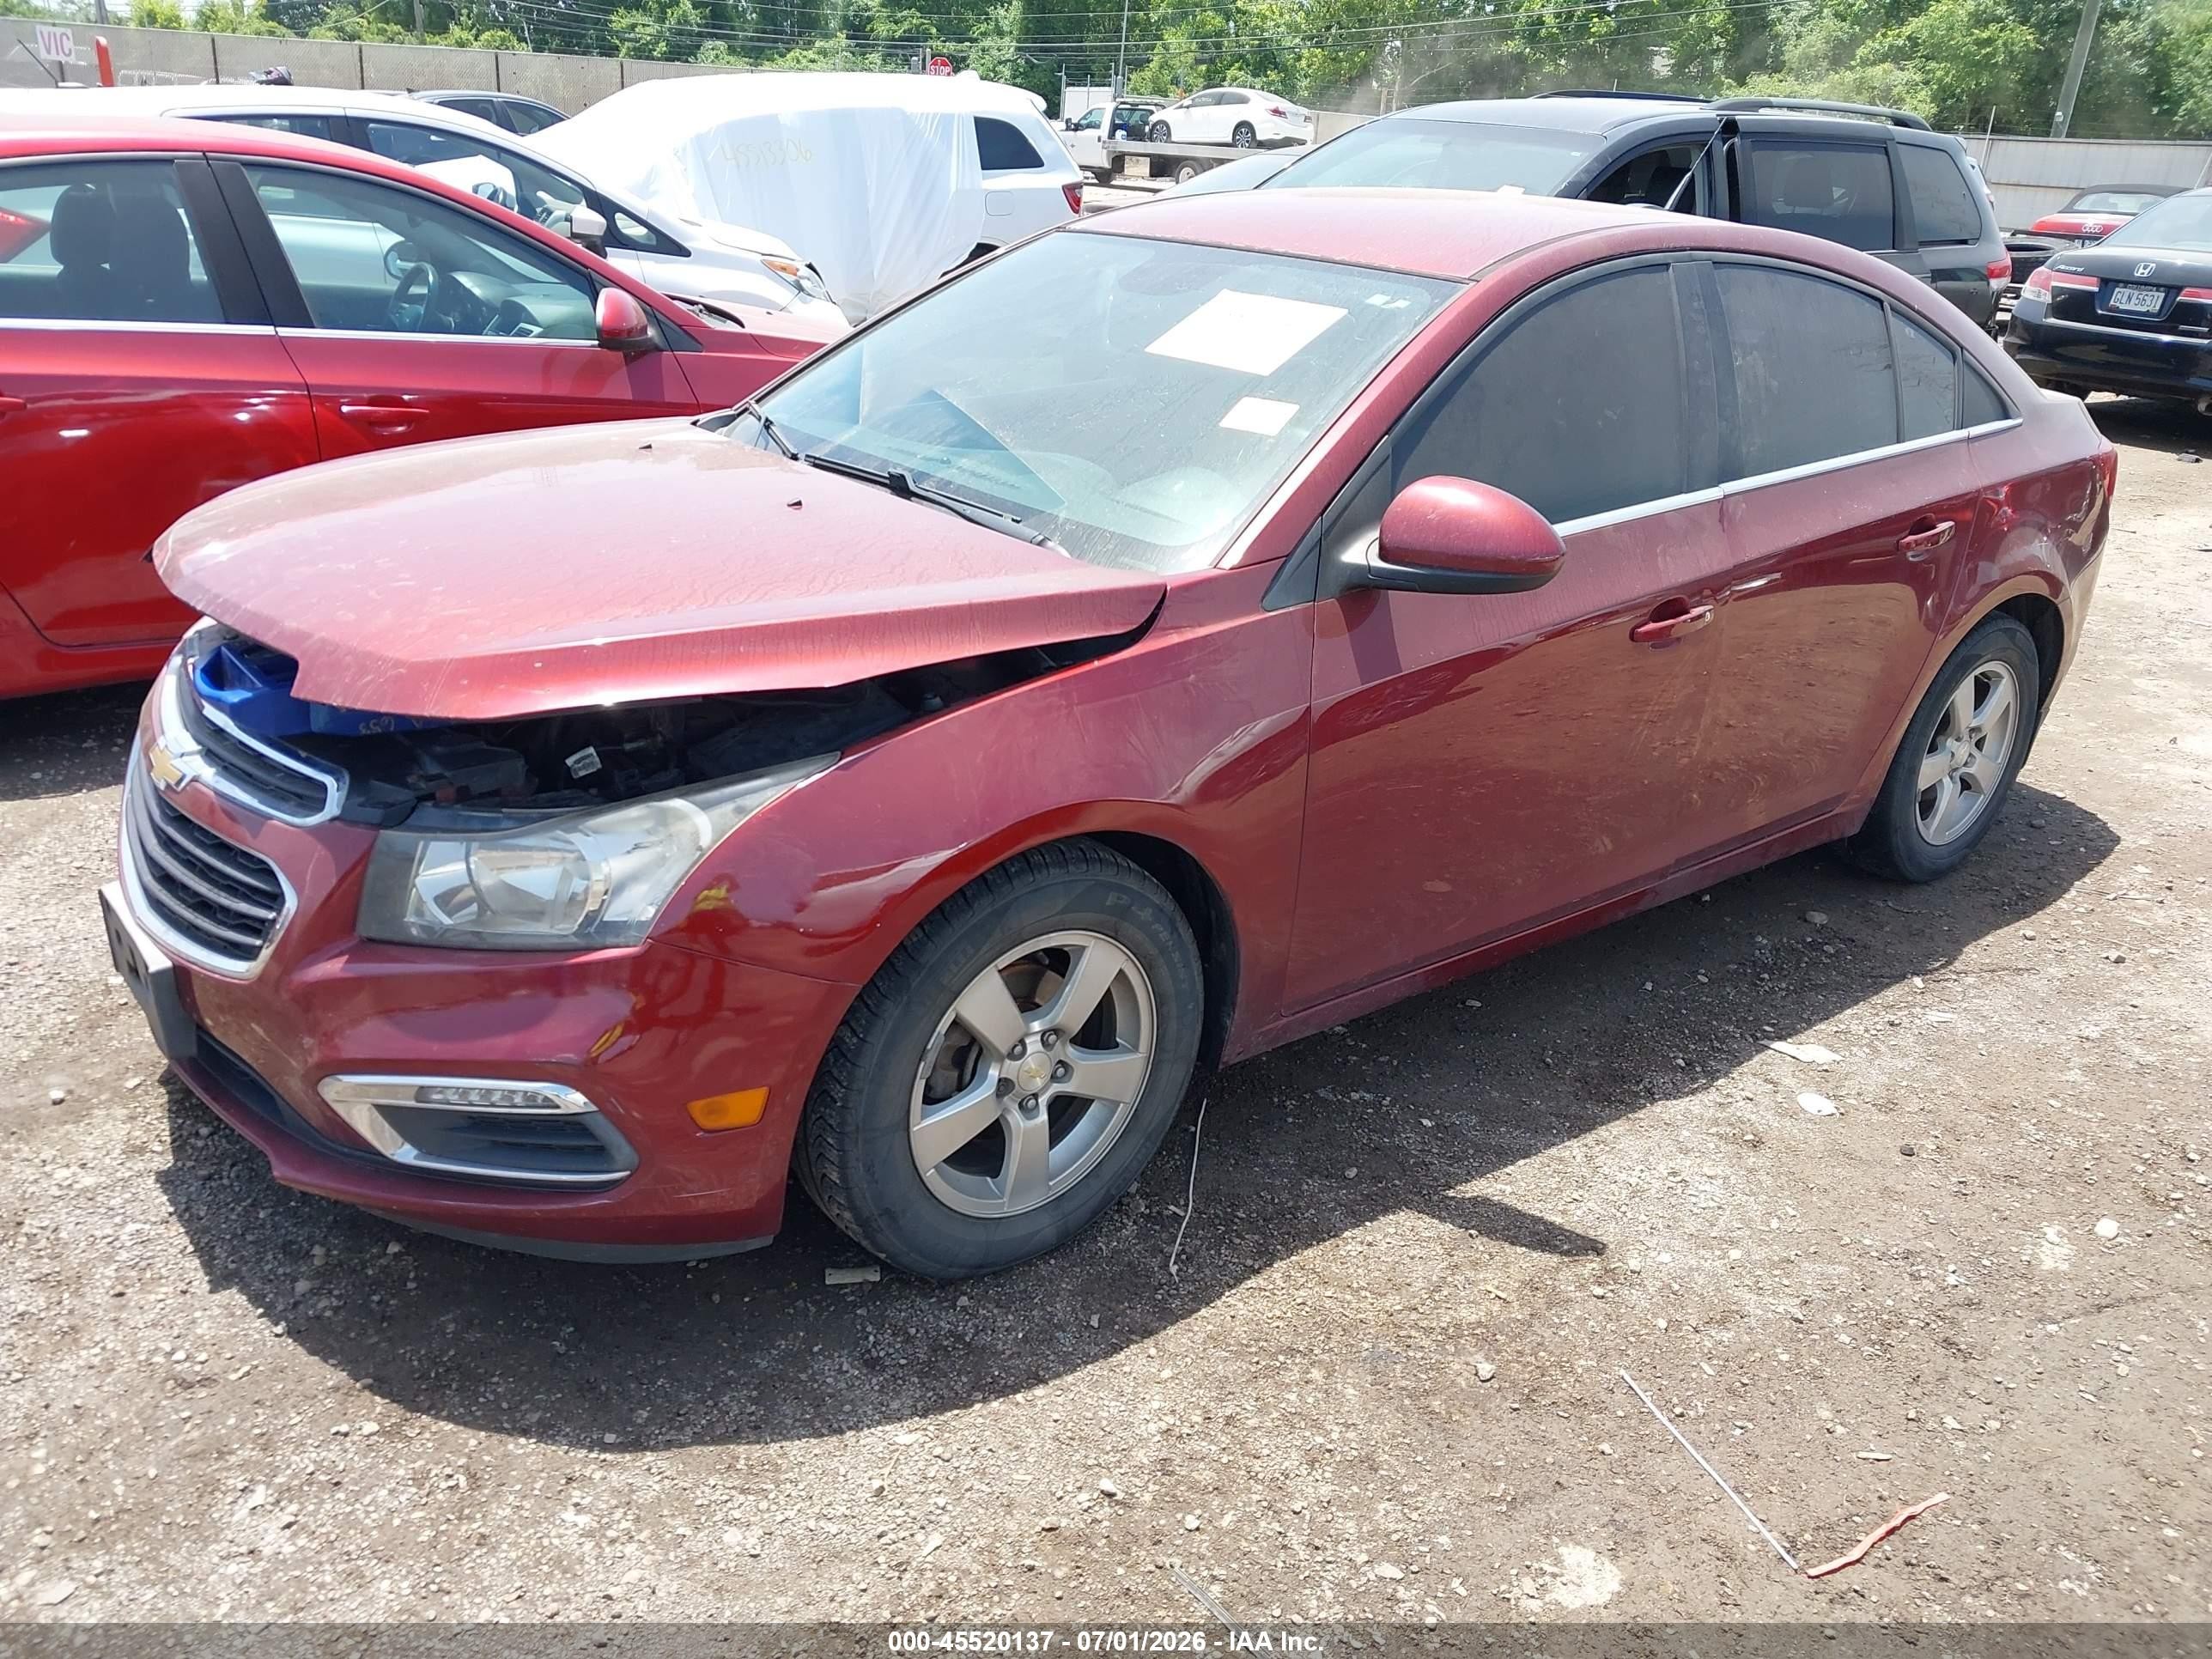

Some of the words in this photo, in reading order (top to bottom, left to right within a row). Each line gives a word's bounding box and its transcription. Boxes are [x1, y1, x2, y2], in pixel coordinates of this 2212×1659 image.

[40, 30, 72, 58] VIC
[930, 65, 951, 76] STOP
[2113, 290, 2135, 305] GLN
[2134, 293, 2160, 309] 5631
